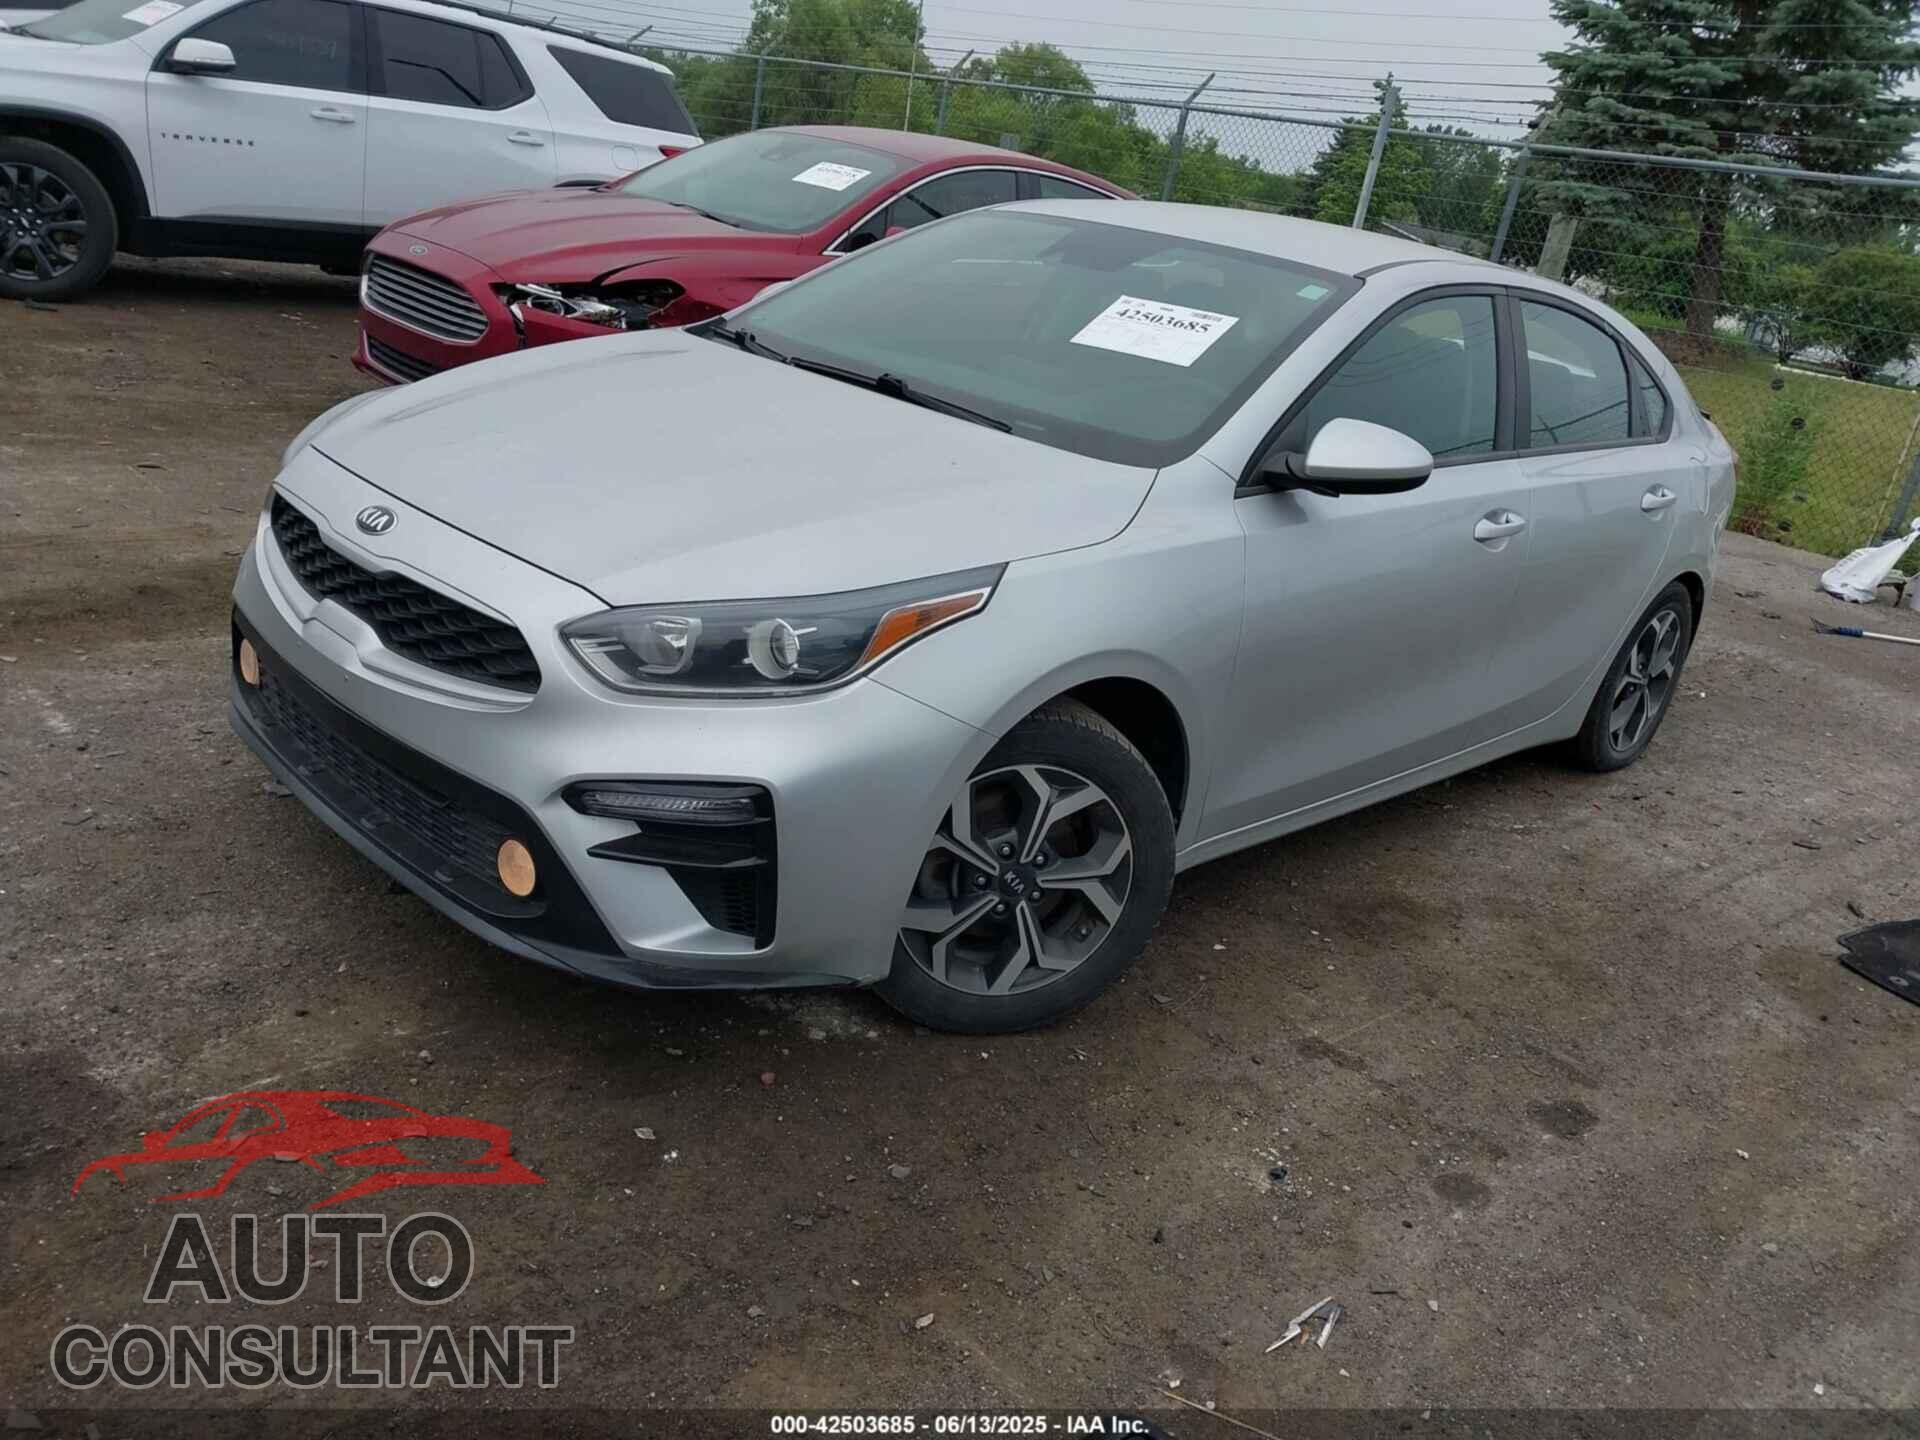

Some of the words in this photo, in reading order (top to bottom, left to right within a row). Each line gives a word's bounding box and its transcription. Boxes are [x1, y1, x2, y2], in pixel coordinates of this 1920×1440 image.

[160, 132, 255, 146] TRAVERSE
[1115, 307, 1212, 333] 42503685
[358, 508, 390, 531] KIA
[1003, 870, 1025, 894] KIA
